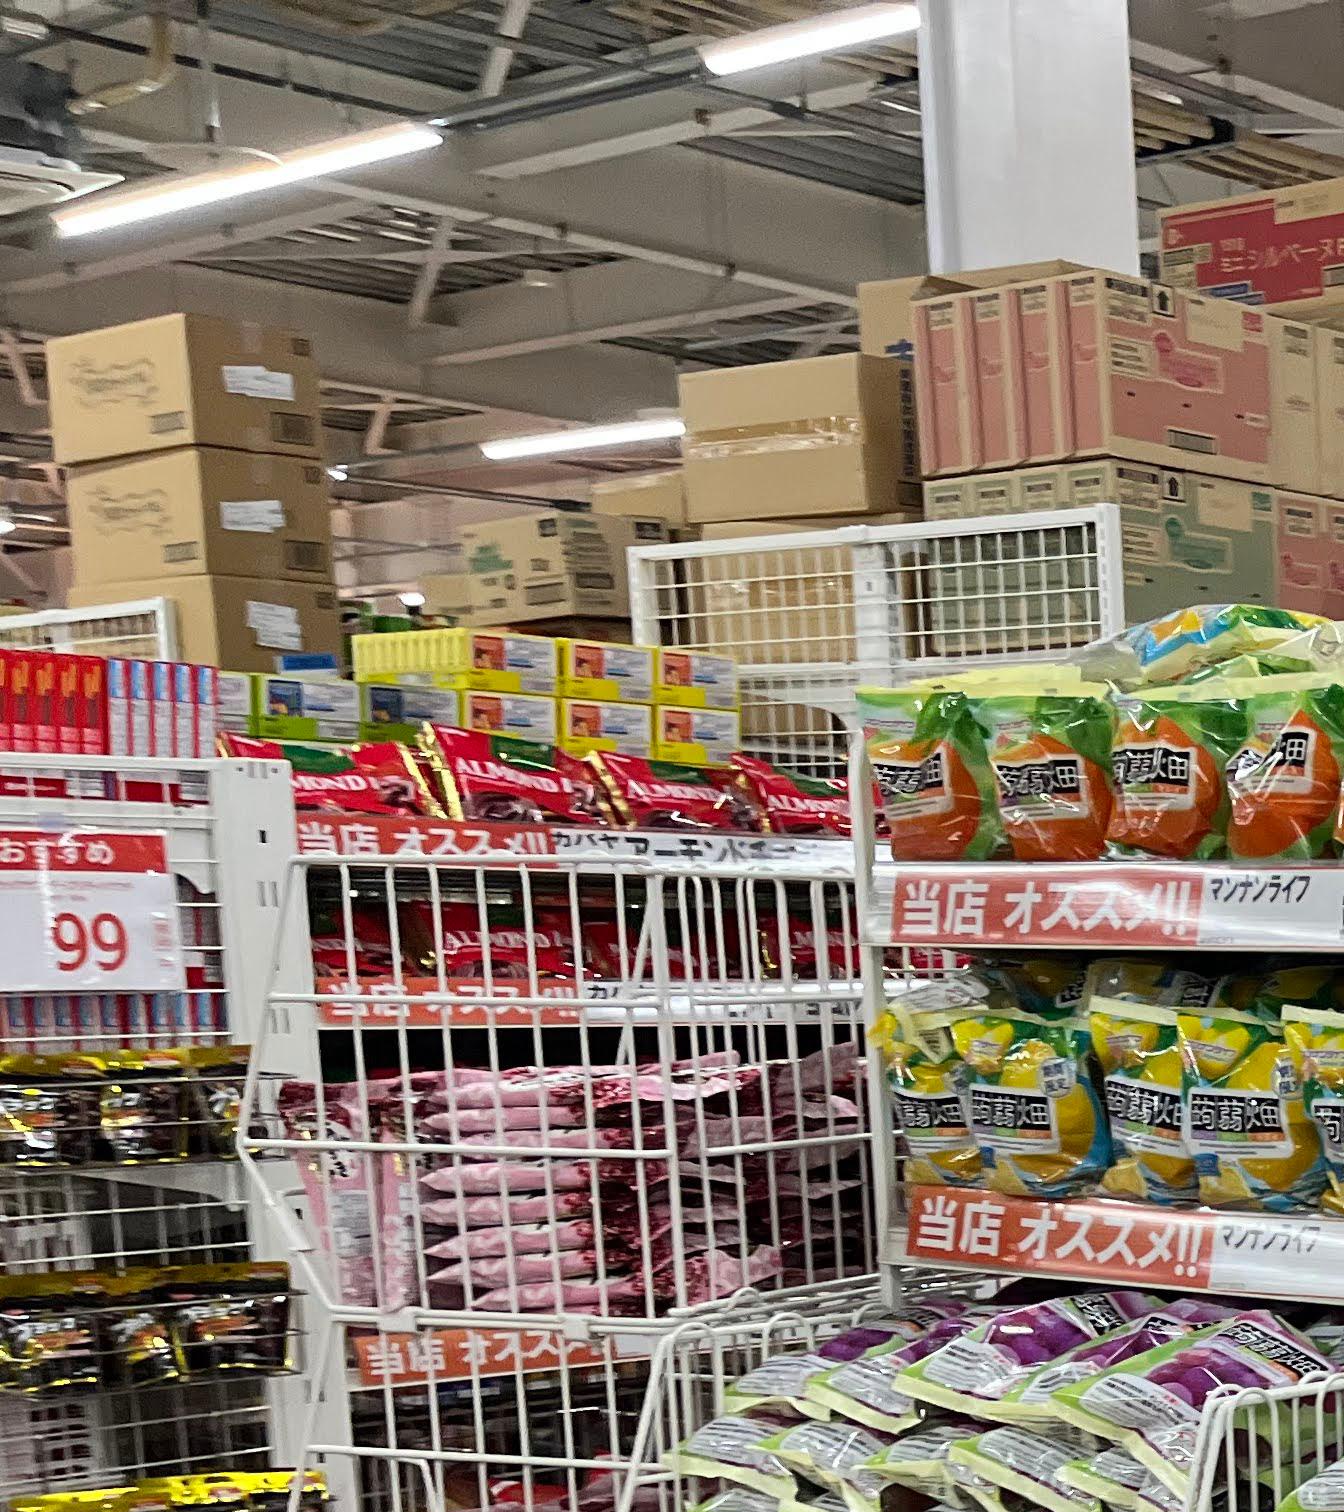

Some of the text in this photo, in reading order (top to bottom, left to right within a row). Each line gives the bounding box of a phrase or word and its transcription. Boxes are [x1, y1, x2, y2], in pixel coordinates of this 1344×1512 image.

[292, 772, 366, 795] MOND
[899, 878, 989, 936] 当店
[1210, 876, 1311, 904] マンナンライフ
[51, 911, 129, 973] 99
[895, 1097, 967, 1129] 蒻畑
[917, 1194, 1007, 1256] 当店
[1019, 1203, 1203, 1277] オススメ!!
[1221, 1223, 1323, 1253] マンナンライフ
